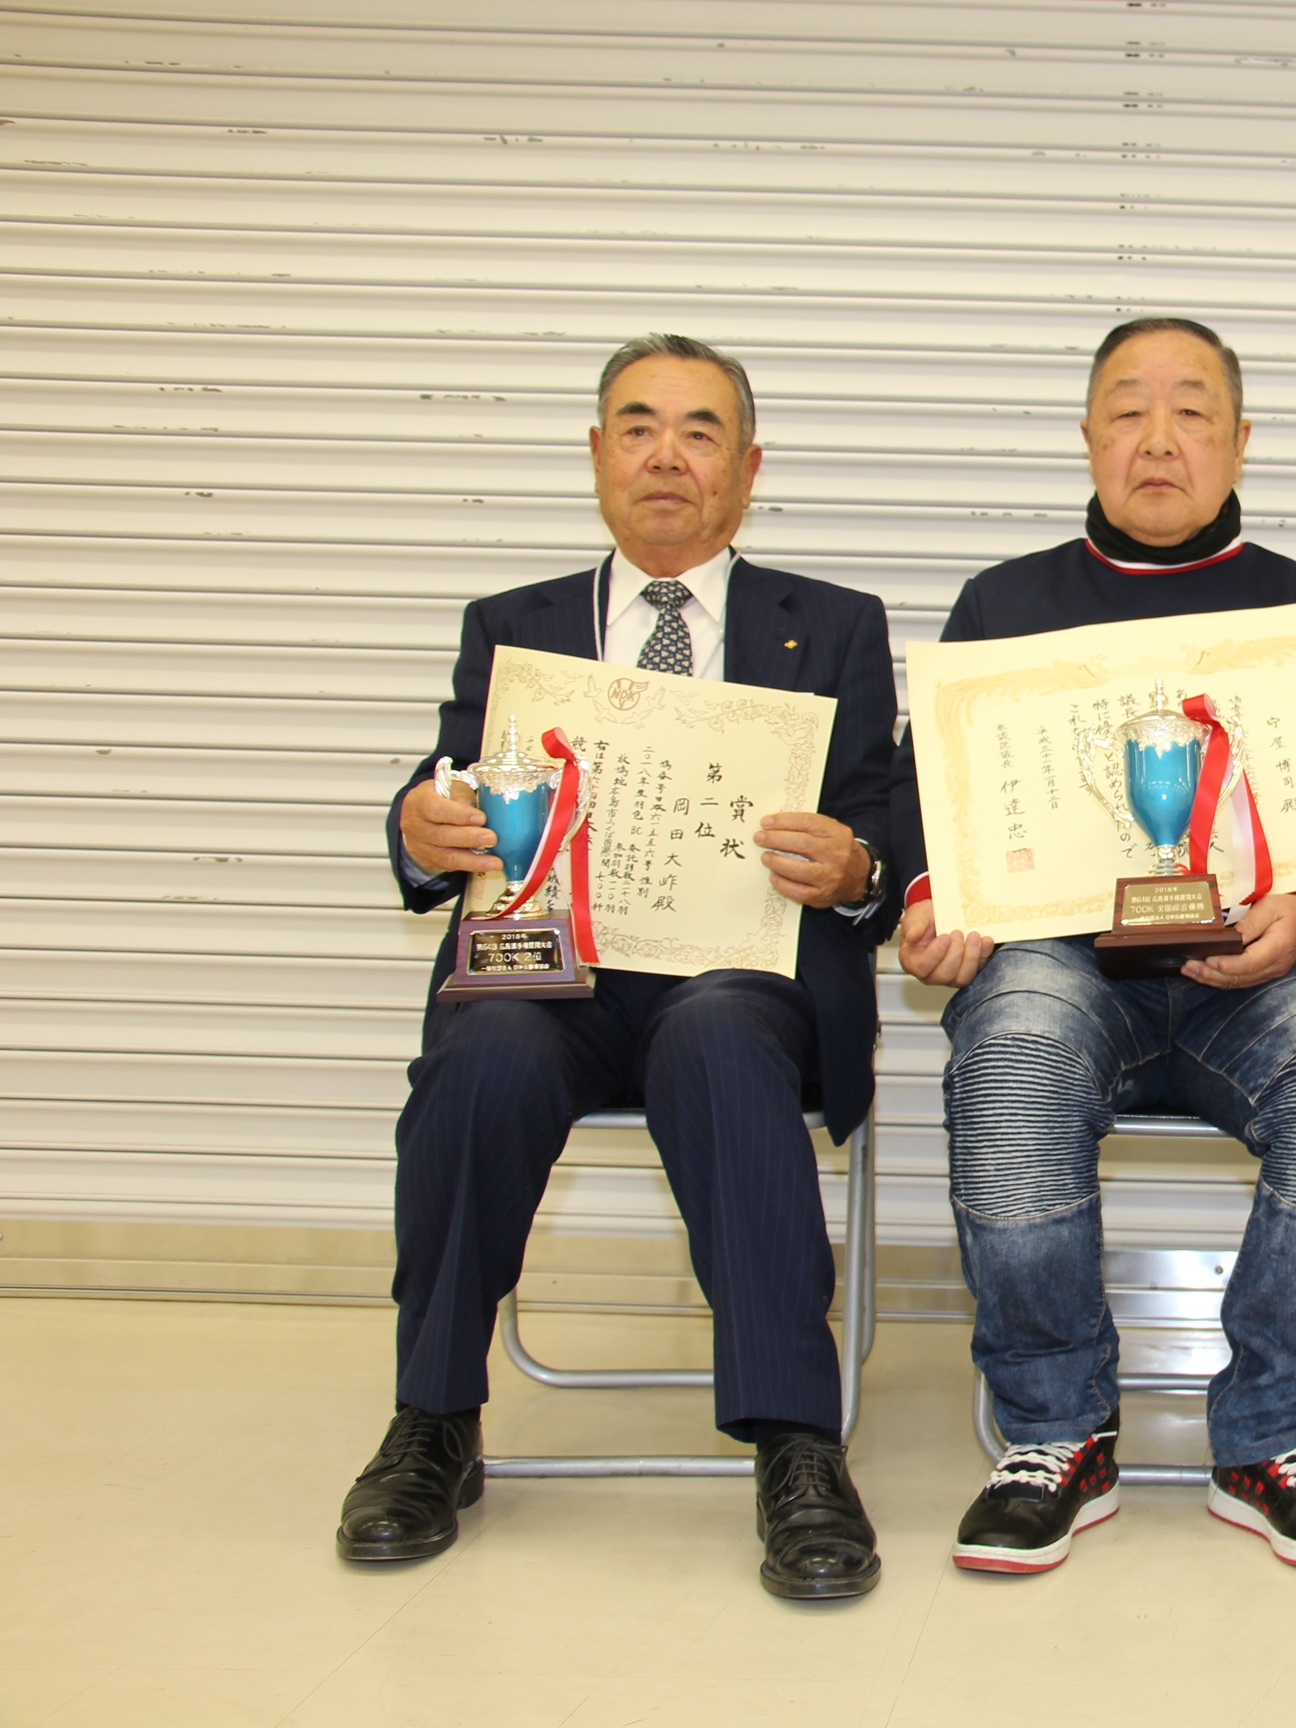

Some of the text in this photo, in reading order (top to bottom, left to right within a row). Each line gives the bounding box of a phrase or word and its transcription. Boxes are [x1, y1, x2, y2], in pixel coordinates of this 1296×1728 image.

[694, 762, 722, 838] 第二位
[720, 795, 754, 860] 賞状
[1130, 905, 1154, 913] 700K
[488, 952, 542, 962] 700K 2位
